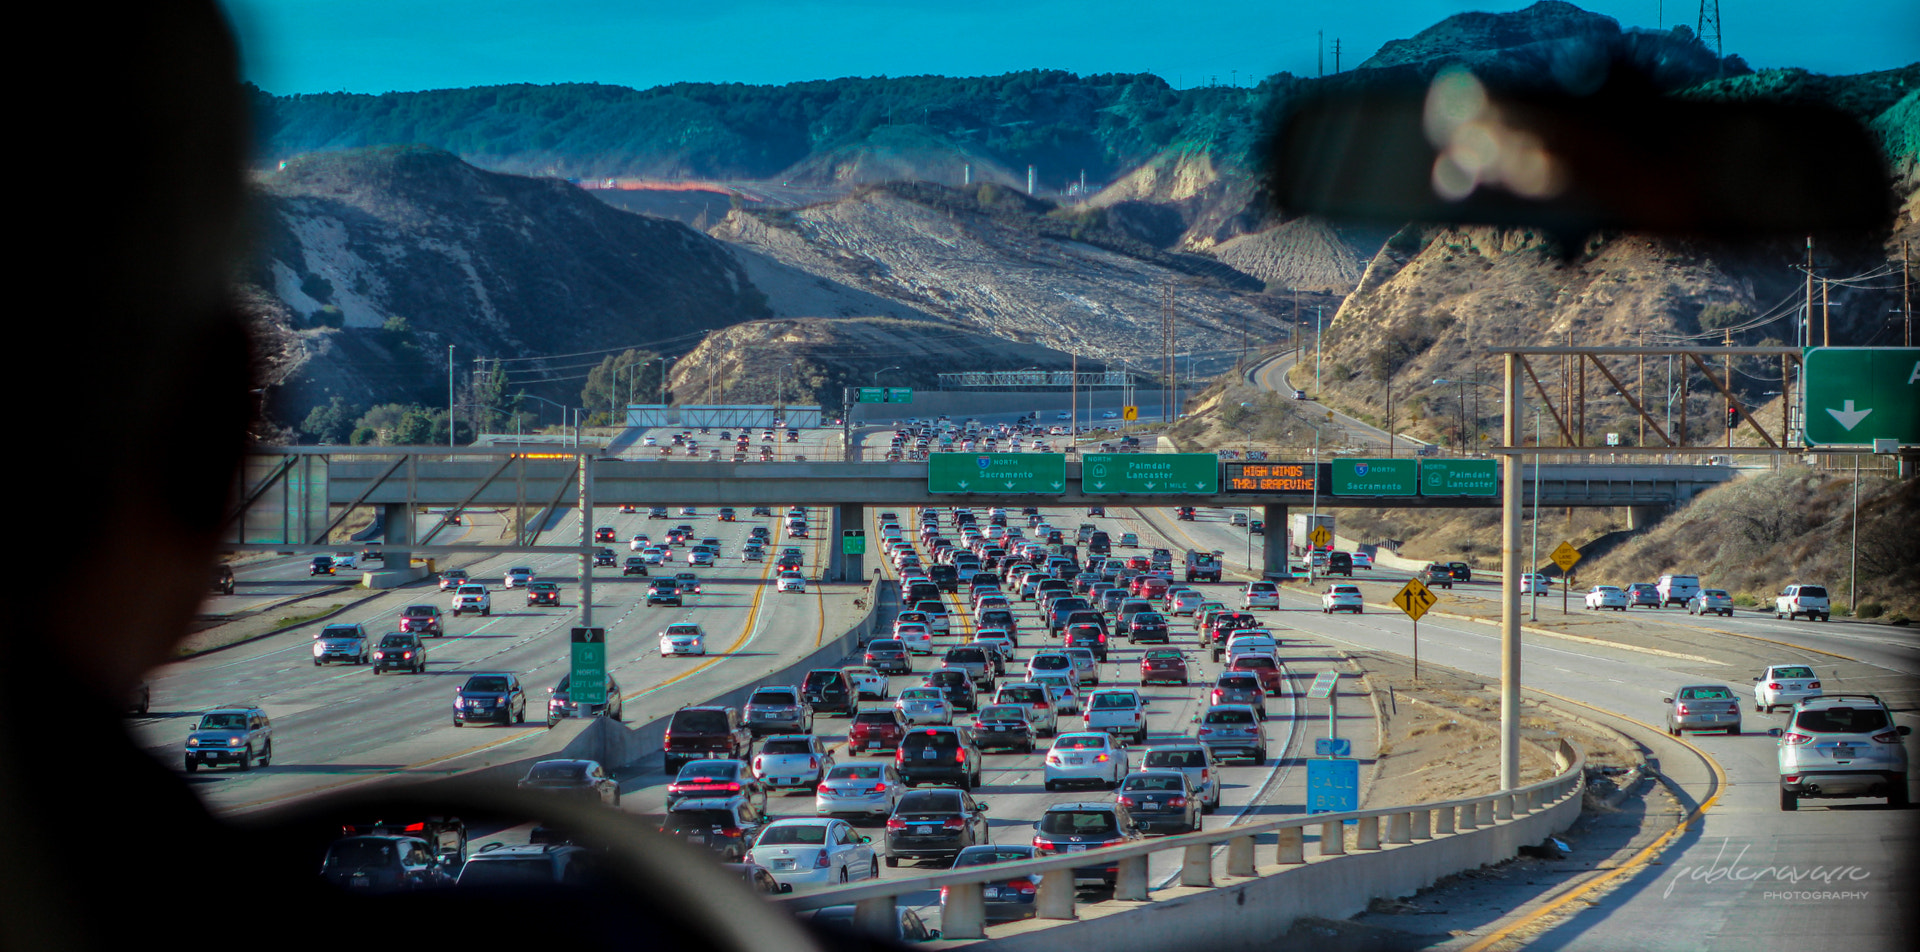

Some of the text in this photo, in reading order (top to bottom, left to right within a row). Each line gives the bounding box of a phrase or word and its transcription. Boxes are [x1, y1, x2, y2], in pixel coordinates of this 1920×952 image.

[1129, 462, 1172, 470] Palmdale
[979, 470, 1034, 479] Sacramento
[1126, 471, 1173, 479] Lancaster
[1242, 465, 1303, 477] HIGH WINDS
[1450, 471, 1491, 479] Palmdale
[1232, 478, 1315, 490] THRU GRAPEVINE
[1347, 482, 1402, 490] Sacramento
[1447, 480, 1494, 488] Lancaster
[573, 680, 604, 688] LEFT LANE
[1312, 777, 1353, 789] CALL
[1317, 795, 1348, 807] BOX
